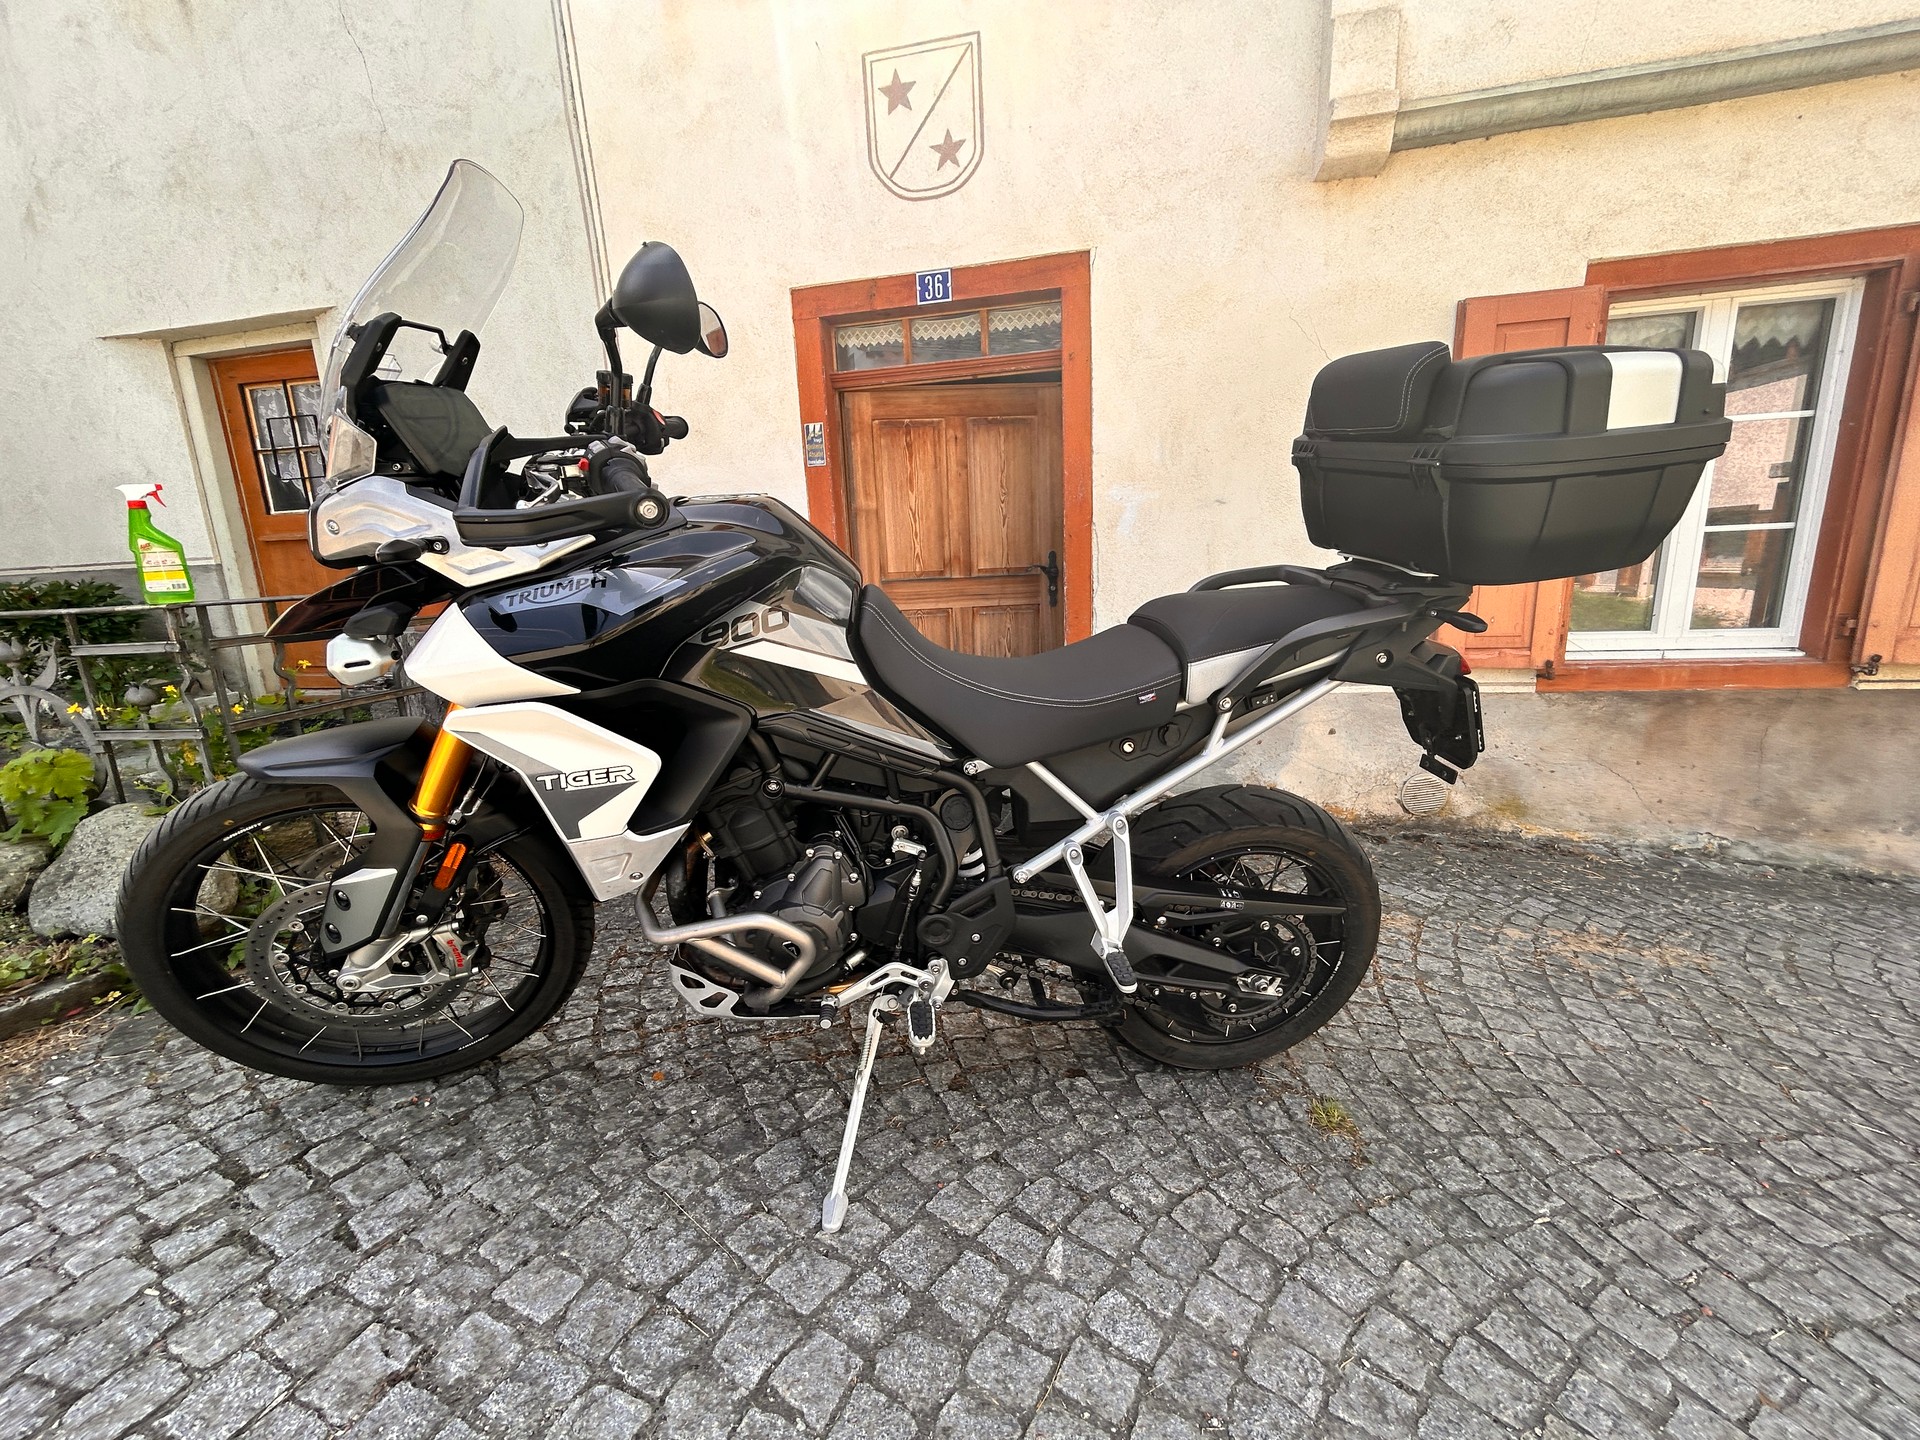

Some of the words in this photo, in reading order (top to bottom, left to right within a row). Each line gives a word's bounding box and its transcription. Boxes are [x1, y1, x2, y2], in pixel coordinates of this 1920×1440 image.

[924, 273, 943, 300] 36
[505, 575, 607, 607] TRIUMPH
[700, 606, 790, 648] 900
[535, 764, 636, 791] TIGER
